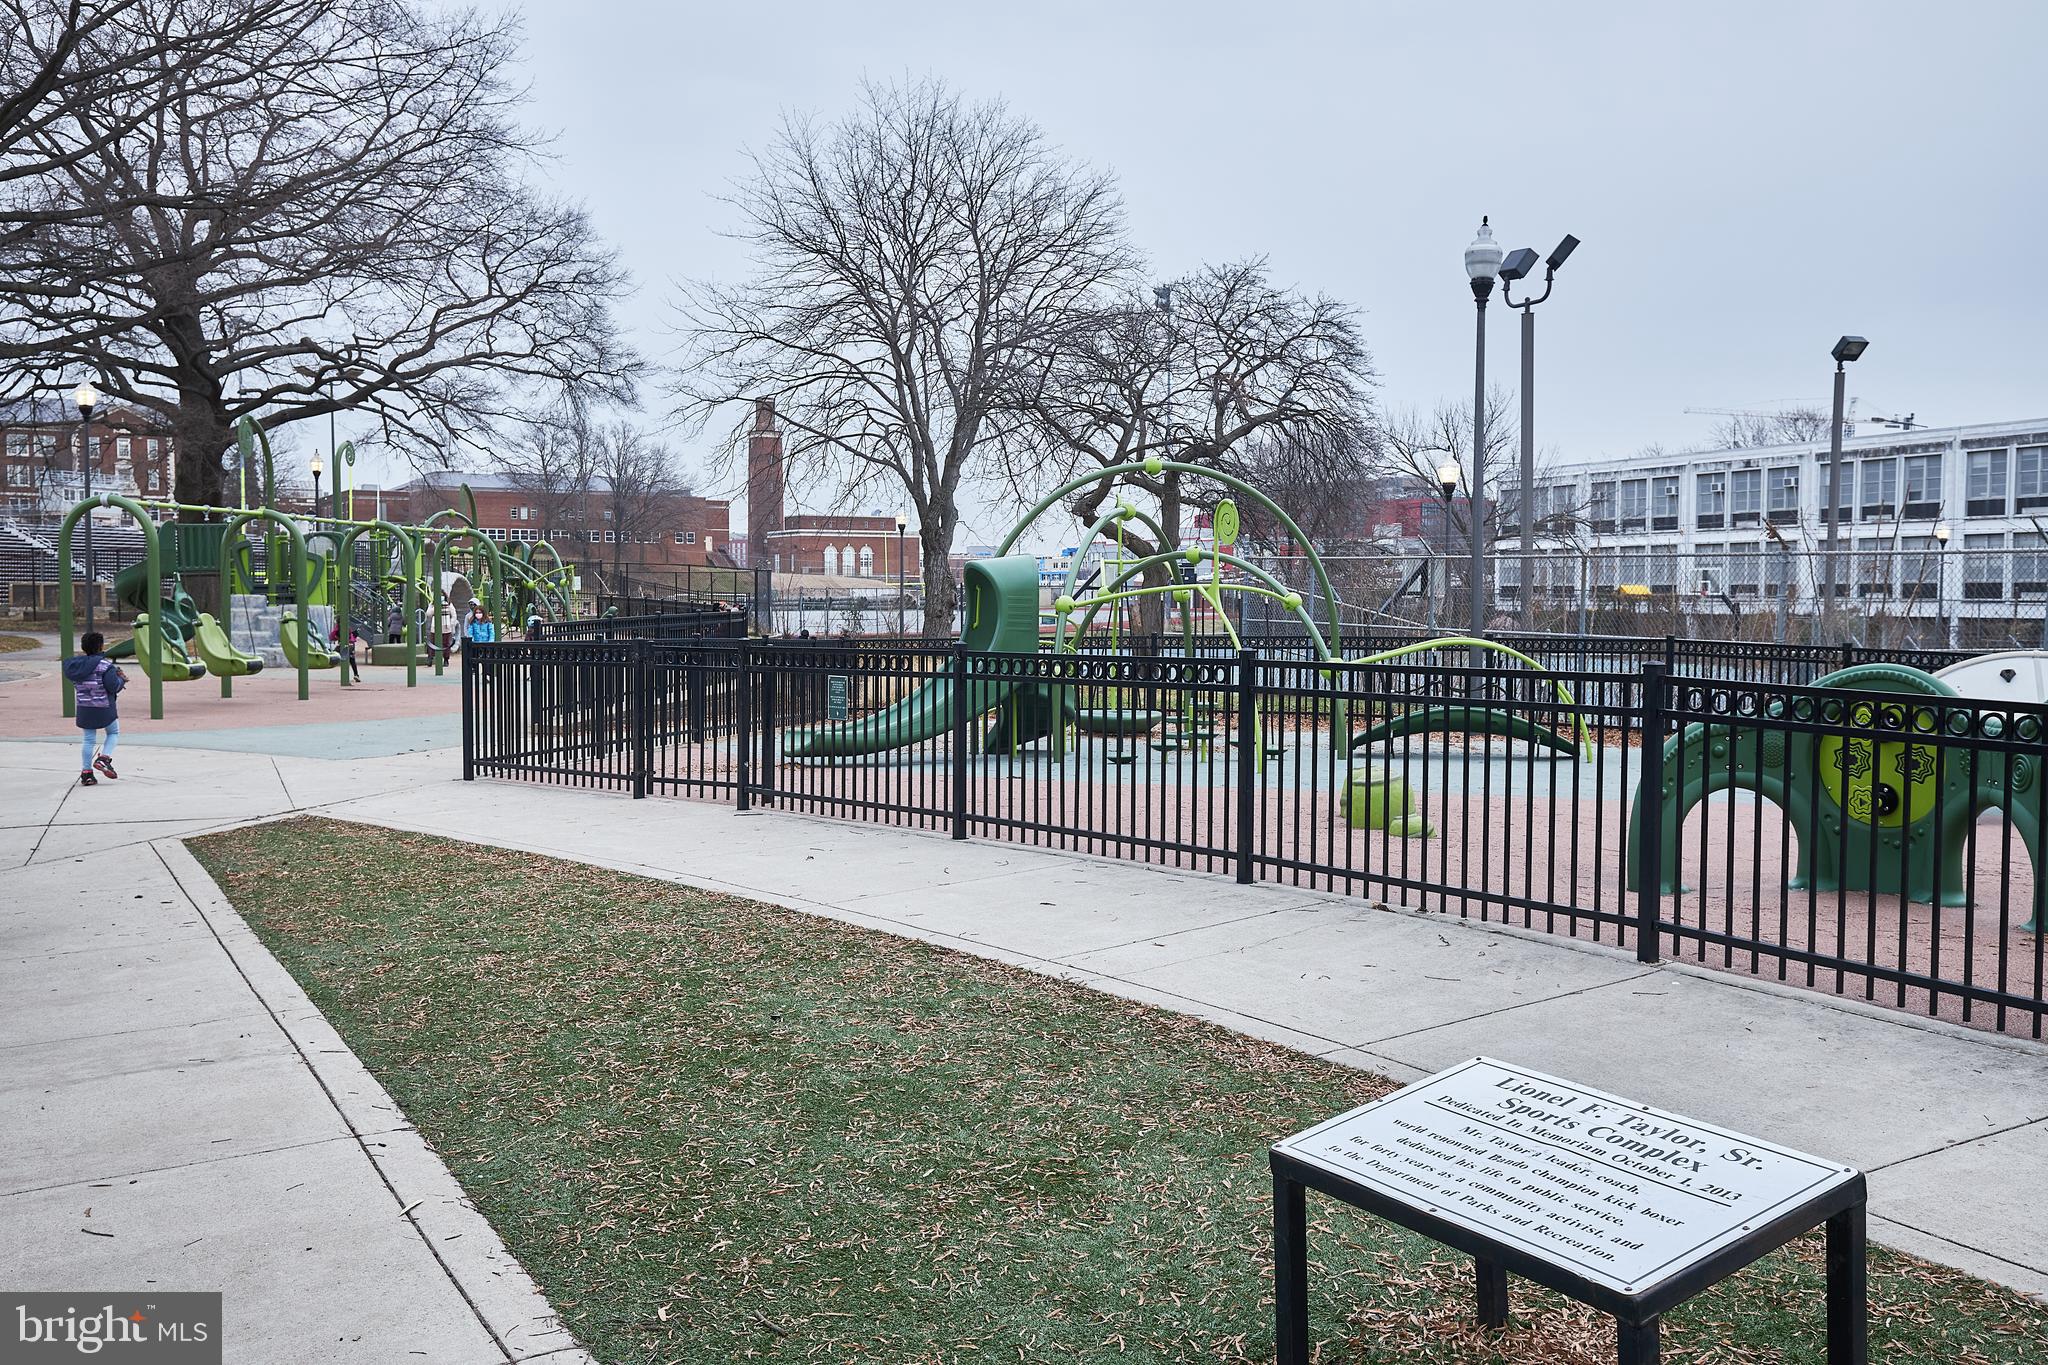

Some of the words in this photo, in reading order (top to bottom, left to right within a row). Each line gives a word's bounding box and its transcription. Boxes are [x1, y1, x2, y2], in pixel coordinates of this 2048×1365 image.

[1392, 1119, 1429, 1134] world
[1426, 1132, 1489, 1156] renowned
[1487, 1153, 1529, 1170] Bando
[1531, 1168, 1600, 1197] champion
[1602, 1194, 1638, 1211] kick
[1639, 1207, 1685, 1227] boxer
[1396, 1137, 1457, 1161] dedicated
[1455, 1158, 1477, 1170] his
[1478, 1166, 1504, 1178] life
[1505, 1176, 1522, 1185] to
[1521, 1184, 1569, 1204] public
[1437, 1095, 1506, 1122] Dedicated
[1505, 1118, 1524, 1129] In
[1525, 1125, 1607, 1157] Memoriam
[1611, 1154, 1677, 1180] October
[1698, 1183, 1743, 1201] 2013
[1459, 1126, 1483, 1139] Mr.
[1488, 1135, 1531, 1154] Taylor
[1493, 1077, 1579, 1108] Lionel
[1578, 1103, 1606, 1119] F.
[1616, 1113, 1706, 1154] Taylor,
[1719, 1148, 1763, 1171] Sr.
[1495, 1097, 1581, 1130] Sports
[1587, 1126, 1709, 1173] Complex
[1328, 1145, 1343, 1153] to
[1343, 1151, 1364, 1161] the
[1365, 1159, 1440, 1191] Department
[1440, 1189, 1461, 1197] of
[1458, 1194, 1501, 1215] Parks
[1501, 1213, 1534, 1227] and
[1532, 1224, 1615, 1262] Recreation.
[1349, 1135, 1370, 1146] for
[1370, 1144, 1399, 1159] forty
[1399, 1157, 1437, 1172] years
[1437, 1171, 1455, 1179] as
[1468, 1181, 1545, 1213] community
[1545, 1212, 1605, 1239] activist,
[1610, 1237, 1645, 1250] and
